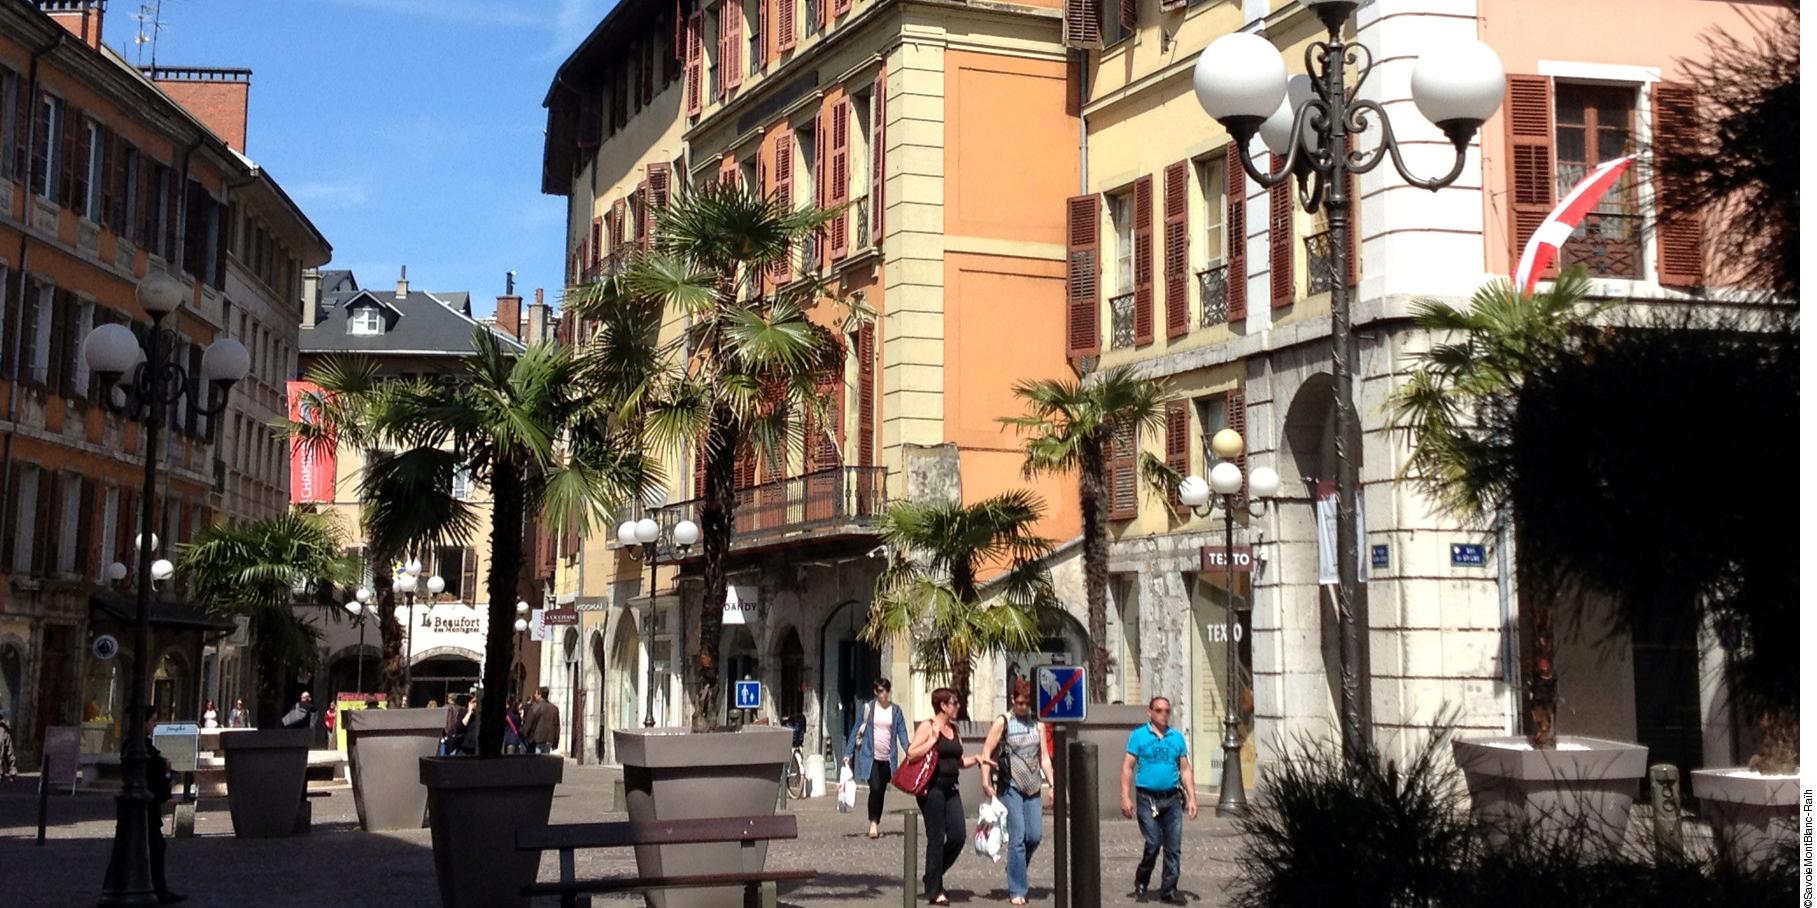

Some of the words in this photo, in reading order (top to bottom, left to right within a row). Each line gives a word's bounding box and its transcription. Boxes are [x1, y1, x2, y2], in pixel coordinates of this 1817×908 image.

[724, 602, 757, 612] DANDY
[435, 616, 480, 627] Beaufort
[1207, 623, 1242, 642] TEXO
